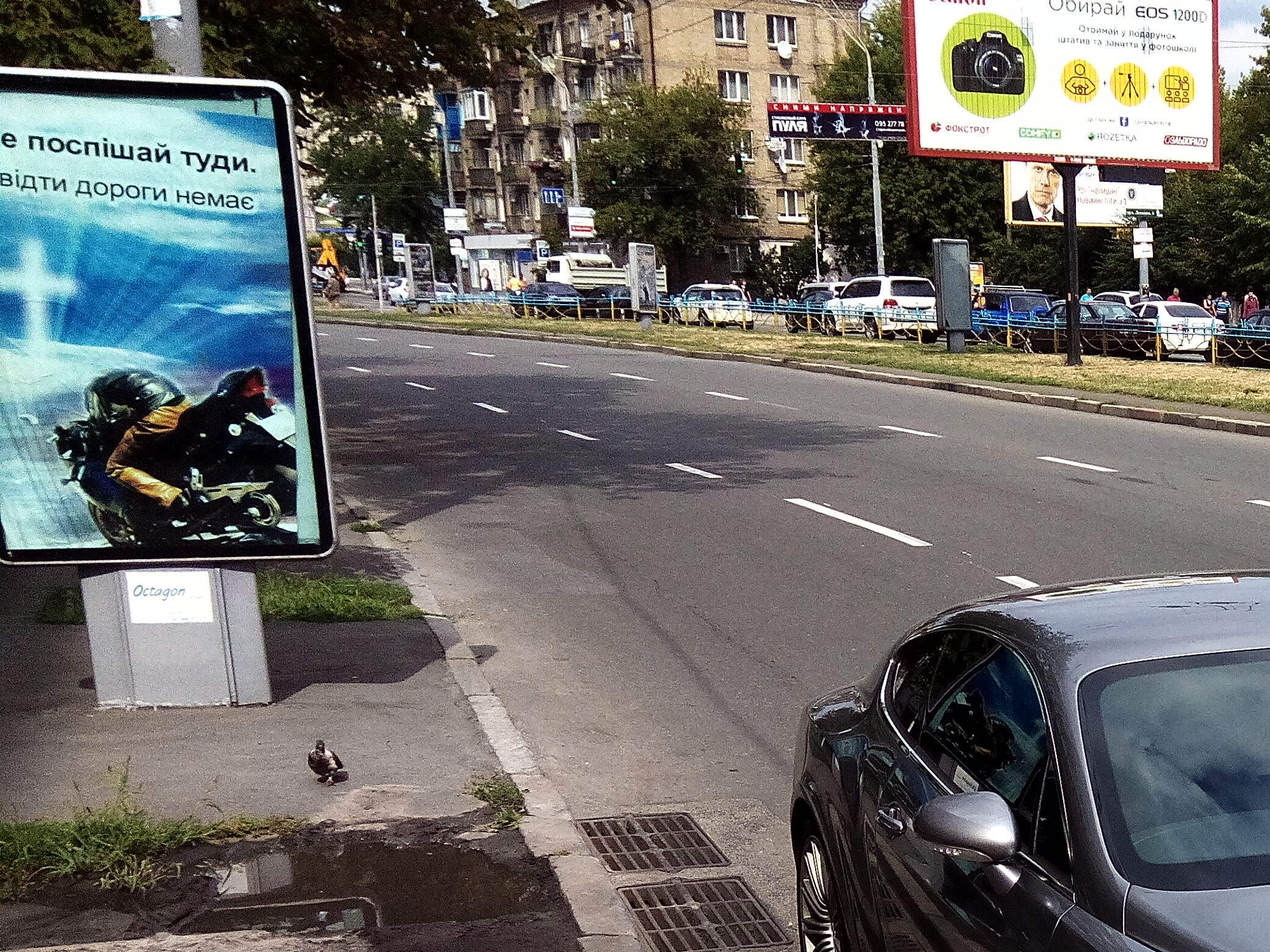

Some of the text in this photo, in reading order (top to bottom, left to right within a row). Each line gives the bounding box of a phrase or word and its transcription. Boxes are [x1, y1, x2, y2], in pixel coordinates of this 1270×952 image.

[1049, 0, 1208, 23] Обирай EOS 1200D
[1078, 24, 1119, 36] Отримай
[830, 105, 902, 114] НАПРЯЖЕН
[772, 120, 809, 133] ПУЛЯ
[945, 124, 990, 134] ФОКСТРОТ
[1, 133, 256, 174] е поспішай туди.
[0, 169, 254, 210] відти дороги немає
[133, 584, 185, 601] Octagon
